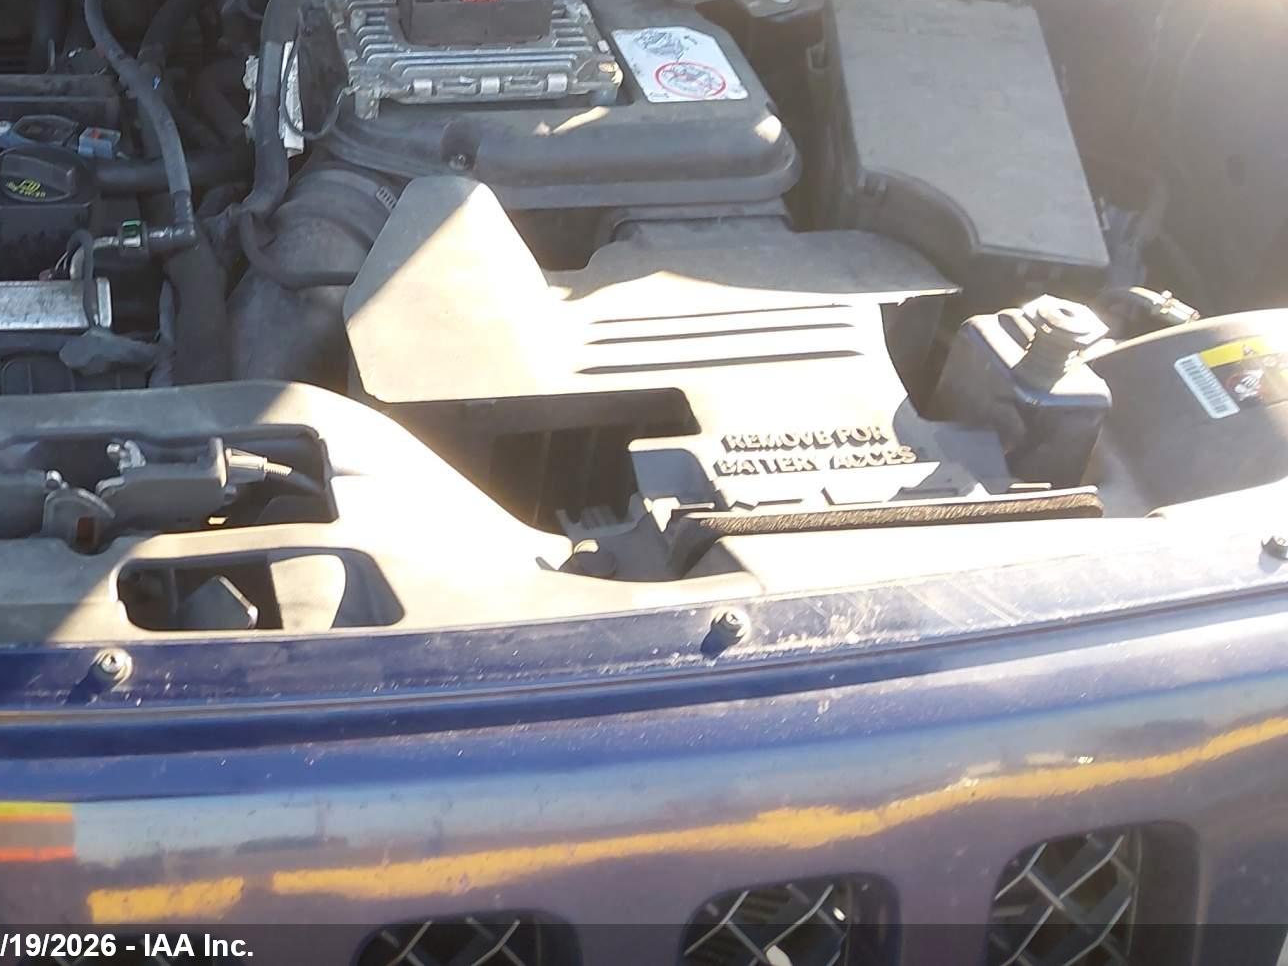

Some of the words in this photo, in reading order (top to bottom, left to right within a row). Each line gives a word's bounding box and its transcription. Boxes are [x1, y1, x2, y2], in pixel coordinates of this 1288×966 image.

[721, 430, 834, 453] REMOVE
[832, 425, 889, 448] FOR
[713, 455, 821, 477] BATTERY
